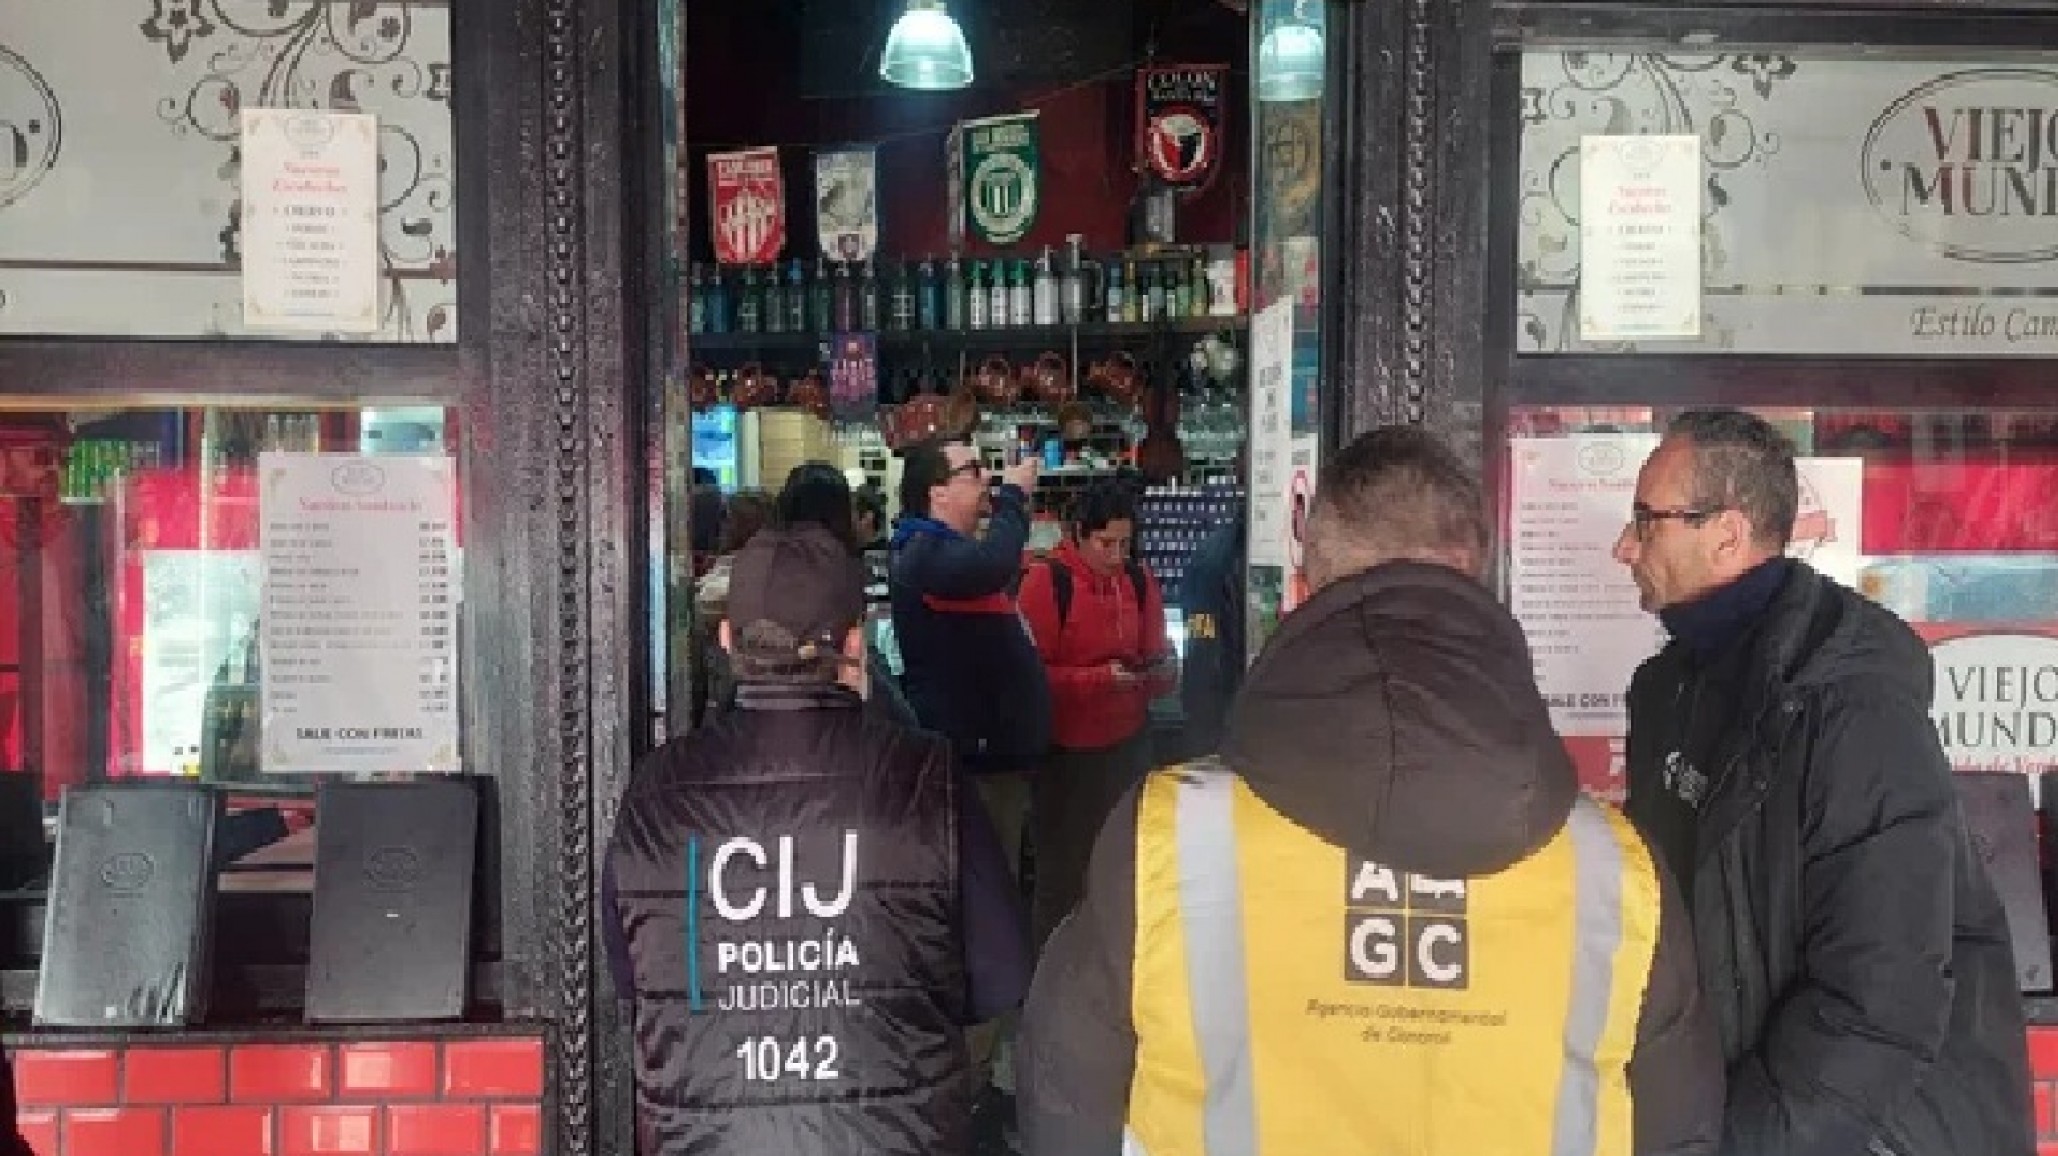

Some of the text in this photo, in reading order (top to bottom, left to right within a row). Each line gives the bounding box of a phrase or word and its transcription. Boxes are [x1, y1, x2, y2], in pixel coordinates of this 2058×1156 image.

[1919, 105, 2058, 173] VIEJ
[1909, 304, 1995, 337] Estilo
[708, 829, 859, 920] CIJ
[718, 927, 860, 973] POLICÍA
[718, 980, 862, 1010] JUDICIAL
[736, 1033, 839, 1081] 1042
